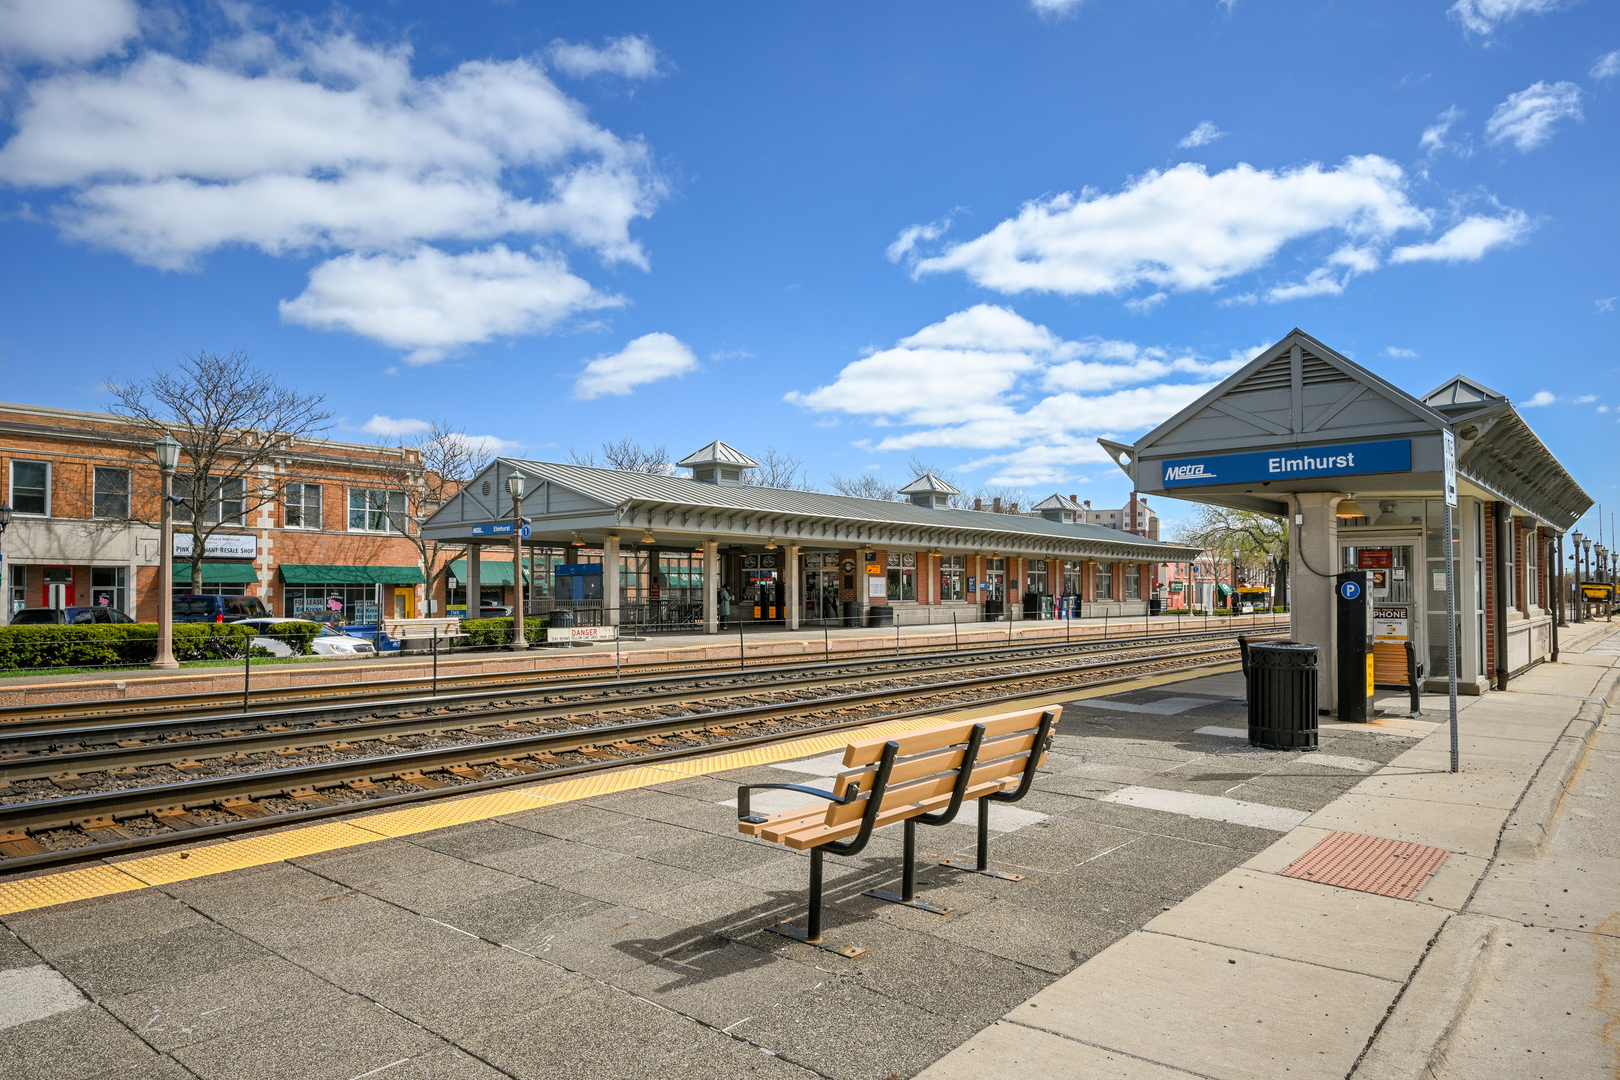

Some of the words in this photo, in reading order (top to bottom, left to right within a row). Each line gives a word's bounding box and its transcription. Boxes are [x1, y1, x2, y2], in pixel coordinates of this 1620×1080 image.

[1165, 464, 1209, 481] Metra
[1269, 453, 1354, 473] Elmhurst
[1346, 584, 1355, 596] P
